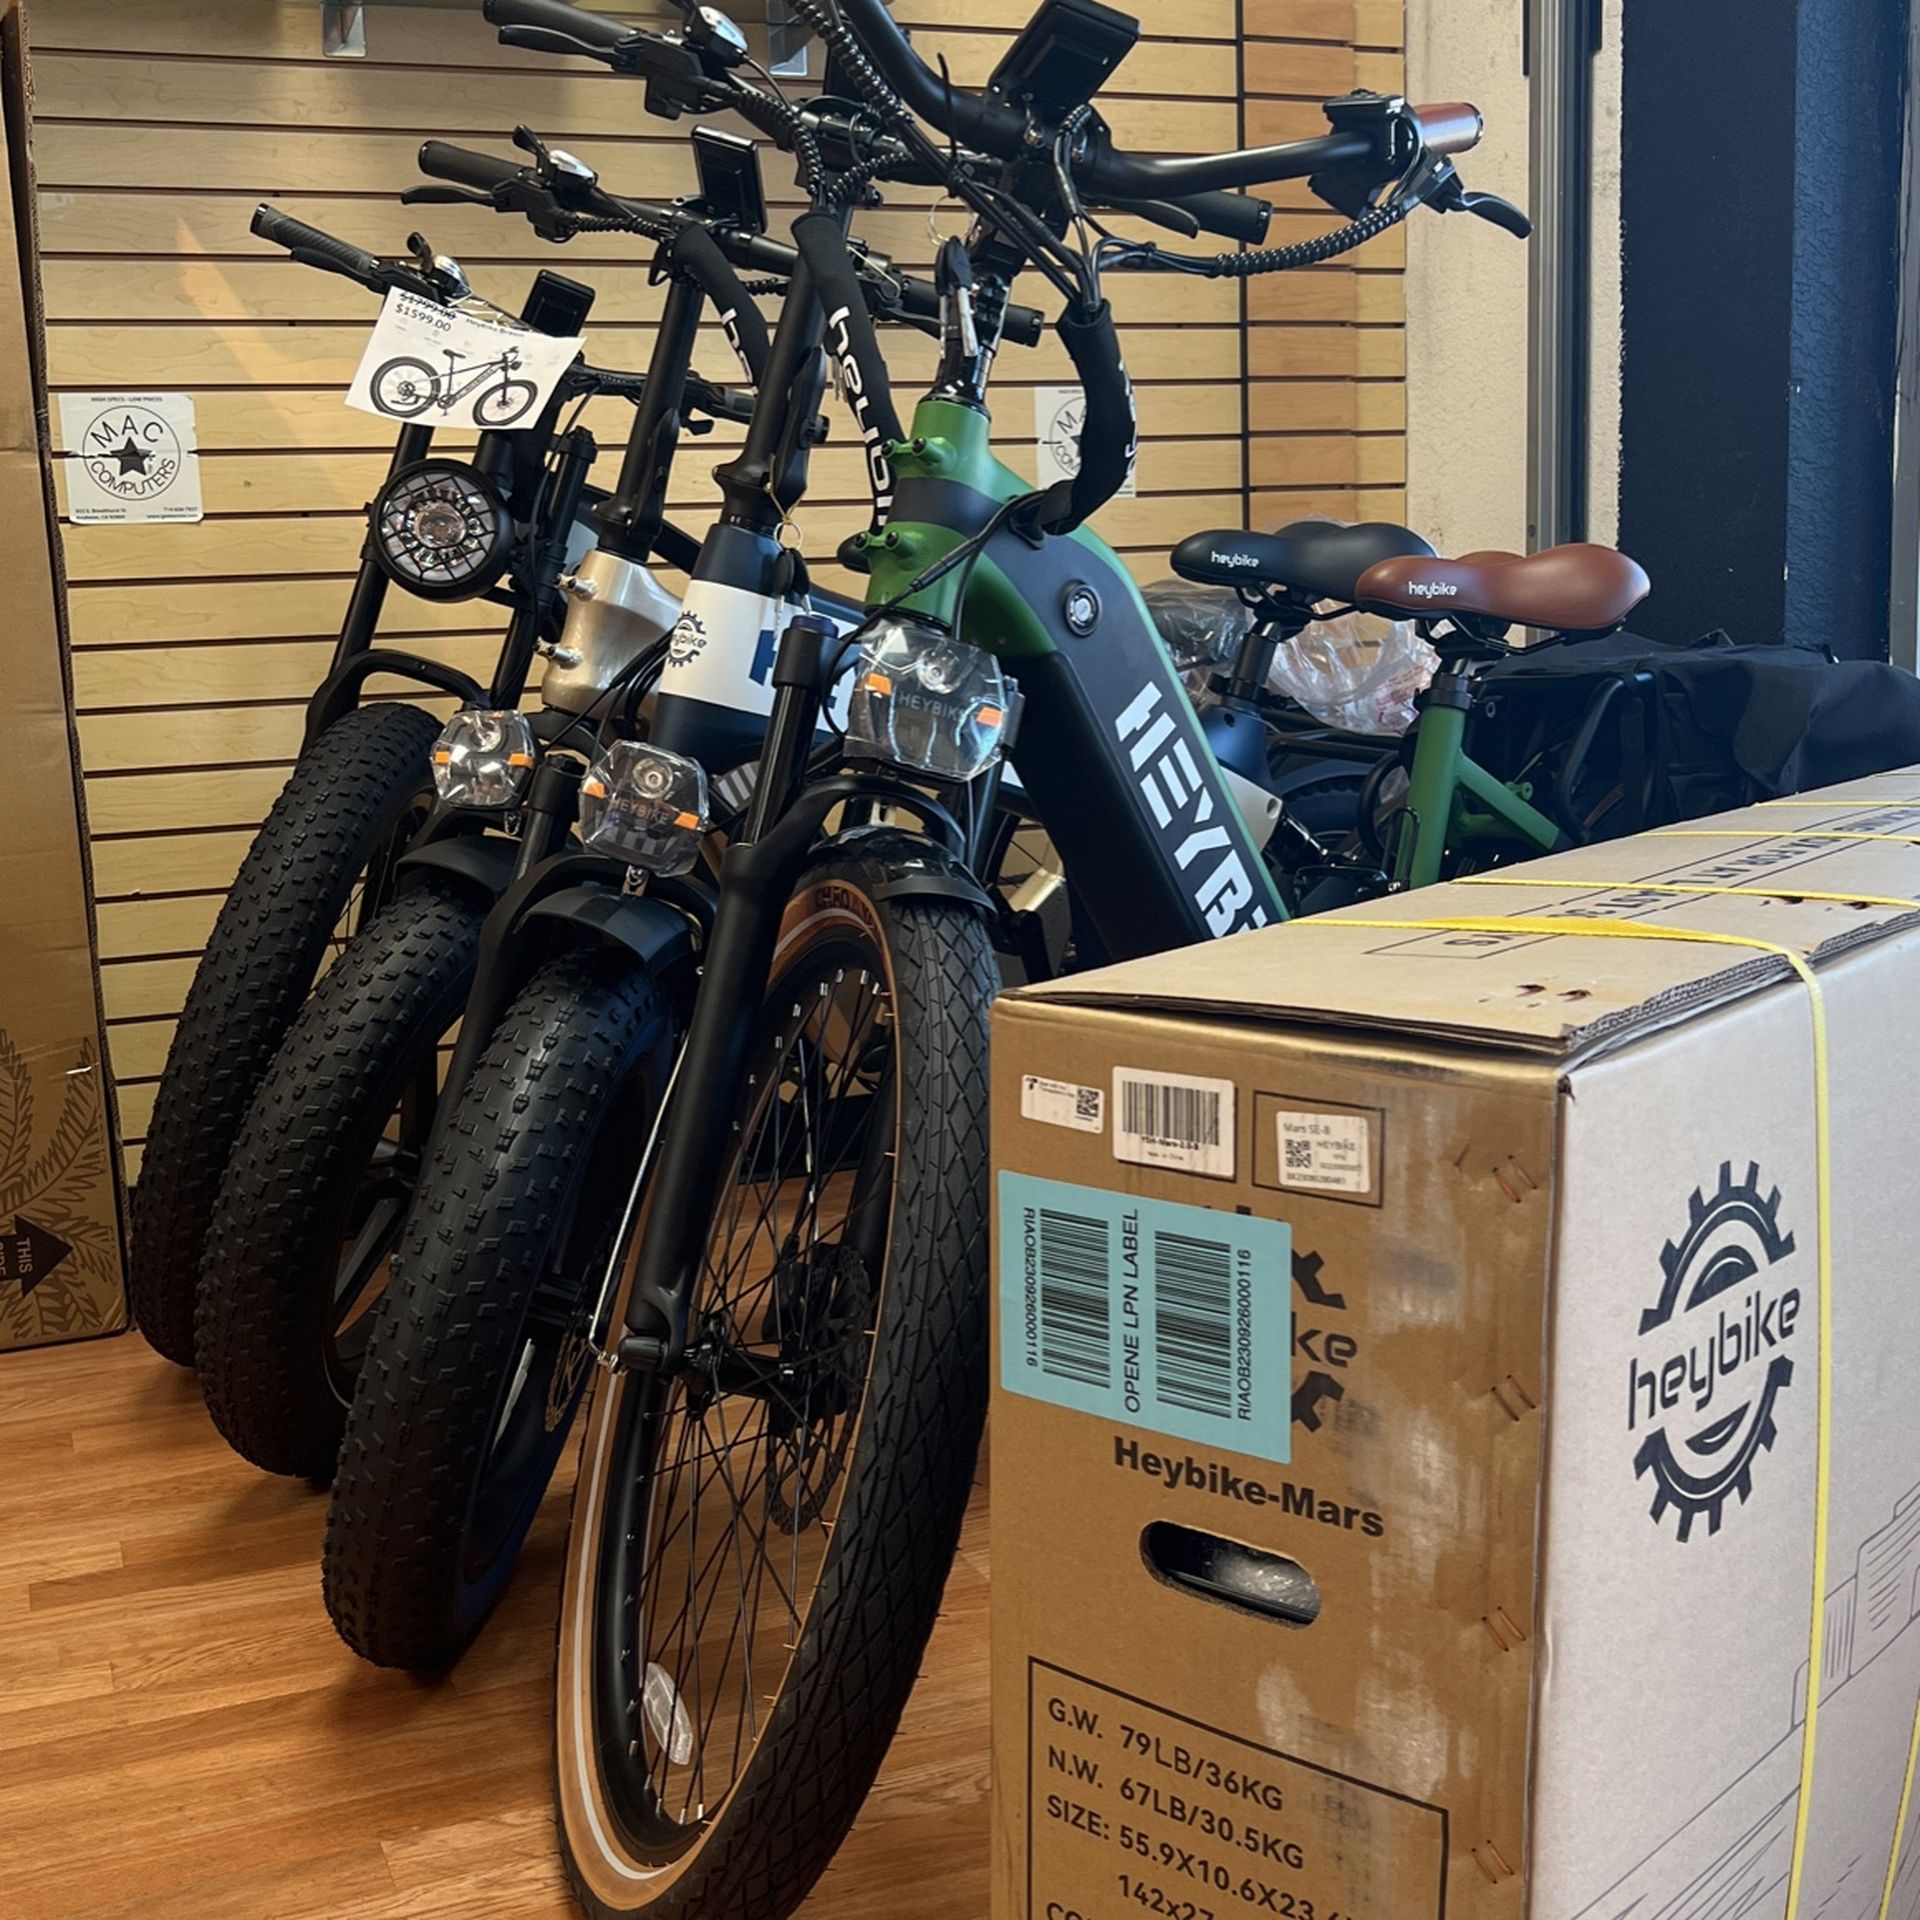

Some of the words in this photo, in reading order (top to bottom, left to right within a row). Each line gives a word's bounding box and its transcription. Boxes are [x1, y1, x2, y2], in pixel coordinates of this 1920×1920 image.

[395, 302, 452, 332] $1599.00
[90, 414, 164, 449] MAC
[90, 457, 176, 496] COMPUTERS
[1210, 550, 1260, 569] heybike
[1407, 580, 1458, 599] heybike
[670, 632, 708, 650] ybike
[611, 798, 671, 826] HEYBIKE
[1115, 681, 1268, 940] HEYB
[16, 1237, 34, 1273] THIS
[1122, 1208, 1139, 1279] LABEL
[1122, 1284, 1140, 1328] LPN
[1236, 1248, 1252, 1421] RIAOB230926000116
[1123, 1333, 1142, 1414] OPENE
[1628, 1287, 1800, 1431] heybike
[1113, 1435, 1385, 1538] Heybike-Mars
[1047, 1697, 1104, 1739] G.W.
[1119, 1724, 1284, 1811] 79LB/36KG
[1046, 1794, 1110, 1840] SIZE:
[1048, 1744, 1104, 1789] N.W.
[1119, 1777, 1304, 1870] 67LB/30.5KG
